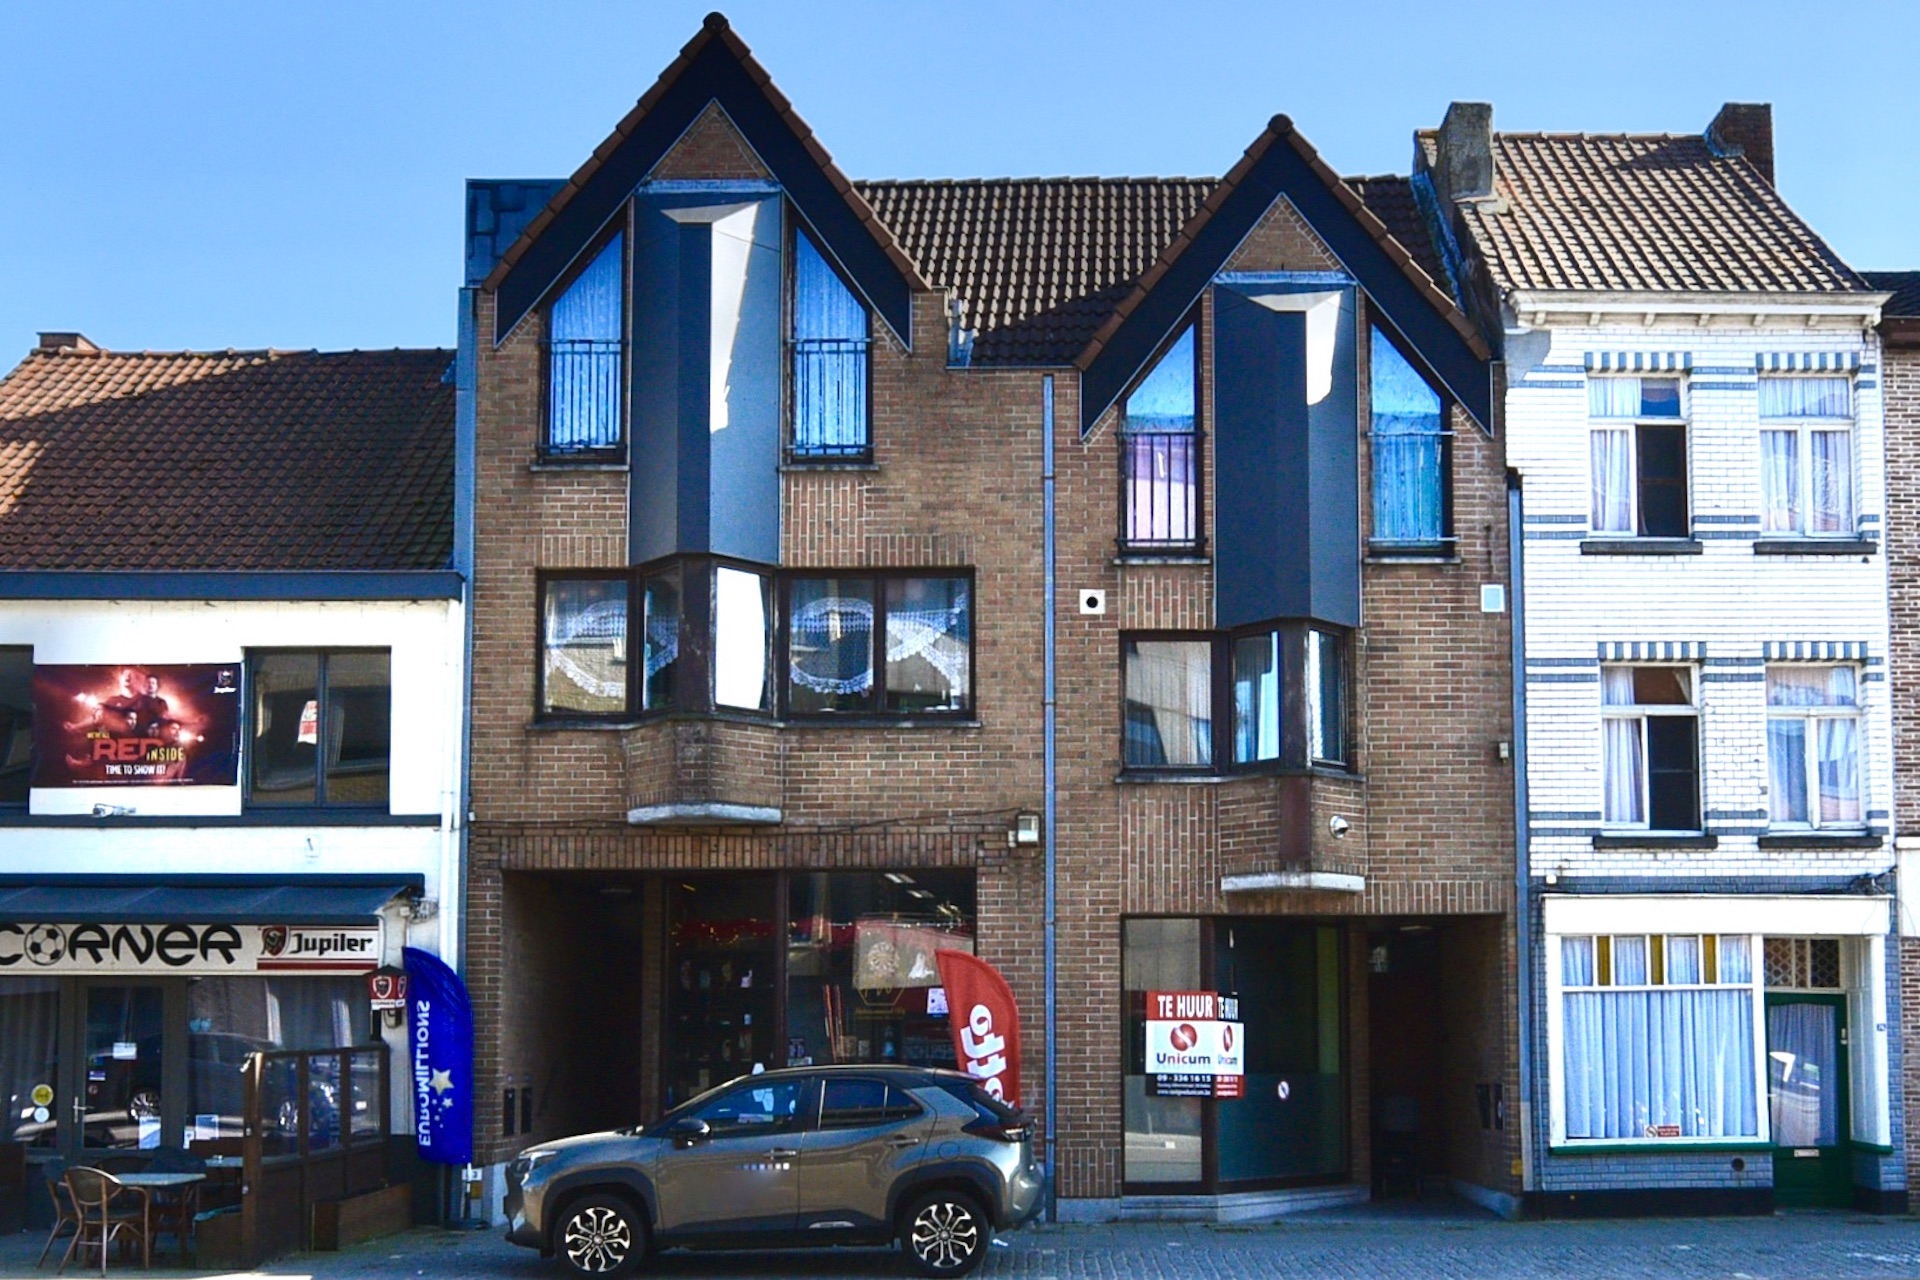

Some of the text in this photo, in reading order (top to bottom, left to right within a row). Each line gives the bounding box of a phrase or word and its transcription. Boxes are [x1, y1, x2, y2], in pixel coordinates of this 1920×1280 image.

[146, 747, 184, 761] INSIDE
[105, 764, 122, 775] TIME
[123, 764, 132, 775] TO
[133, 764, 155, 775] SHOW
[289, 933, 373, 956] Jupiler
[1157, 995, 1213, 1018] TE HUUR
[1217, 996, 1225, 1019] TE
[1156, 1053, 1211, 1065] Unicum
